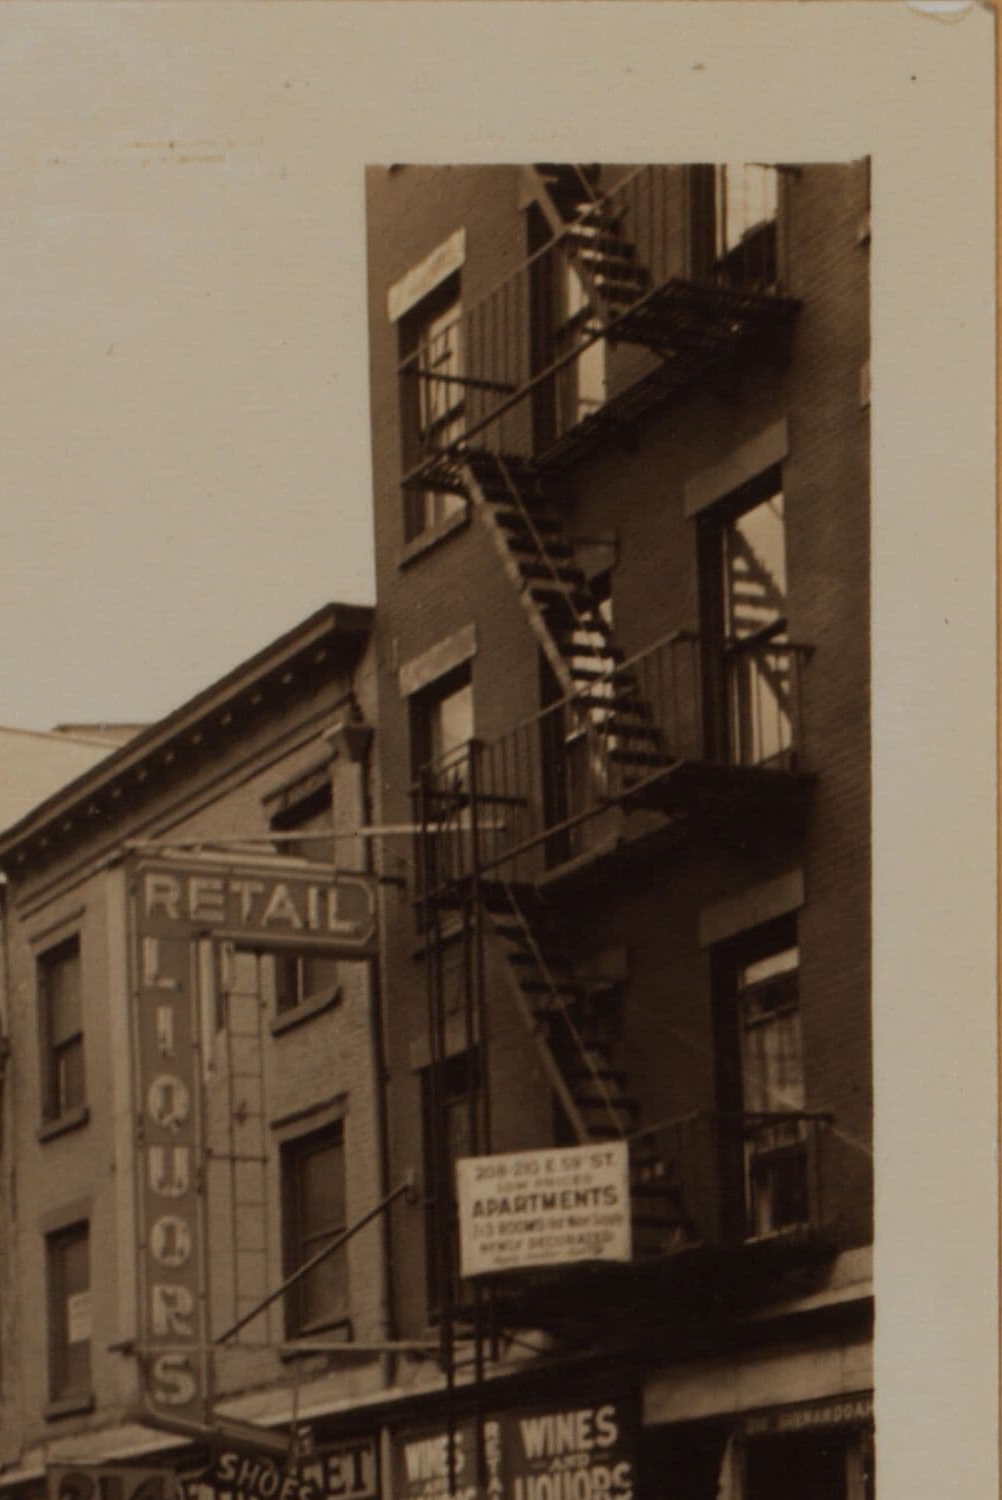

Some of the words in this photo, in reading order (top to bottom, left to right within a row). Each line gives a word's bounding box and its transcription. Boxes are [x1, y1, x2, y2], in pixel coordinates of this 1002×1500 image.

[143, 872, 360, 934] RETAIL
[143, 936, 197, 1406] LIQUORS
[472, 1184, 619, 1219] APARTMENTS
[520, 1404, 619, 1459] WINES
